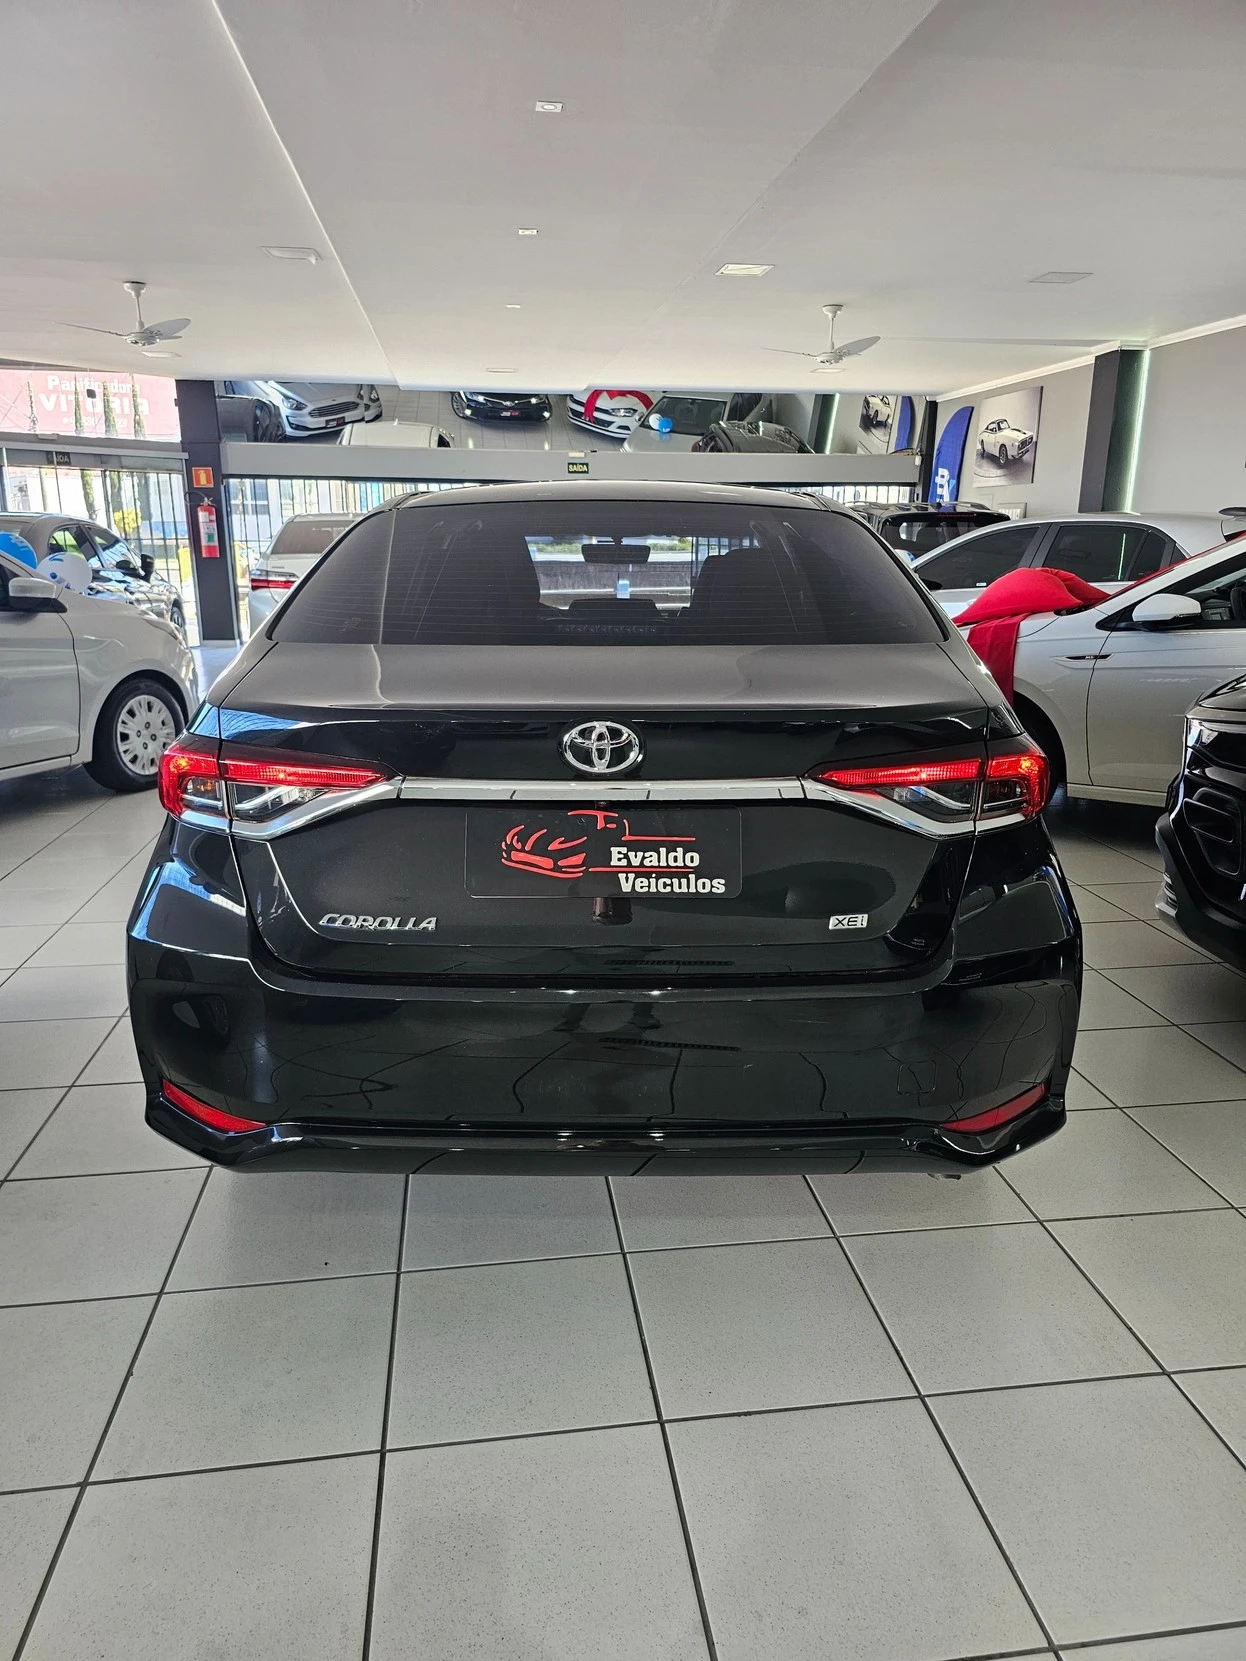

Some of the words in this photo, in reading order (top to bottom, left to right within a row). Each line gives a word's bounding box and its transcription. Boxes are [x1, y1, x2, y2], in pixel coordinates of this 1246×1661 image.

[610, 846, 700, 867] Evaldo
[618, 873, 726, 893] Veículos
[319, 913, 437, 931] COROLLA
